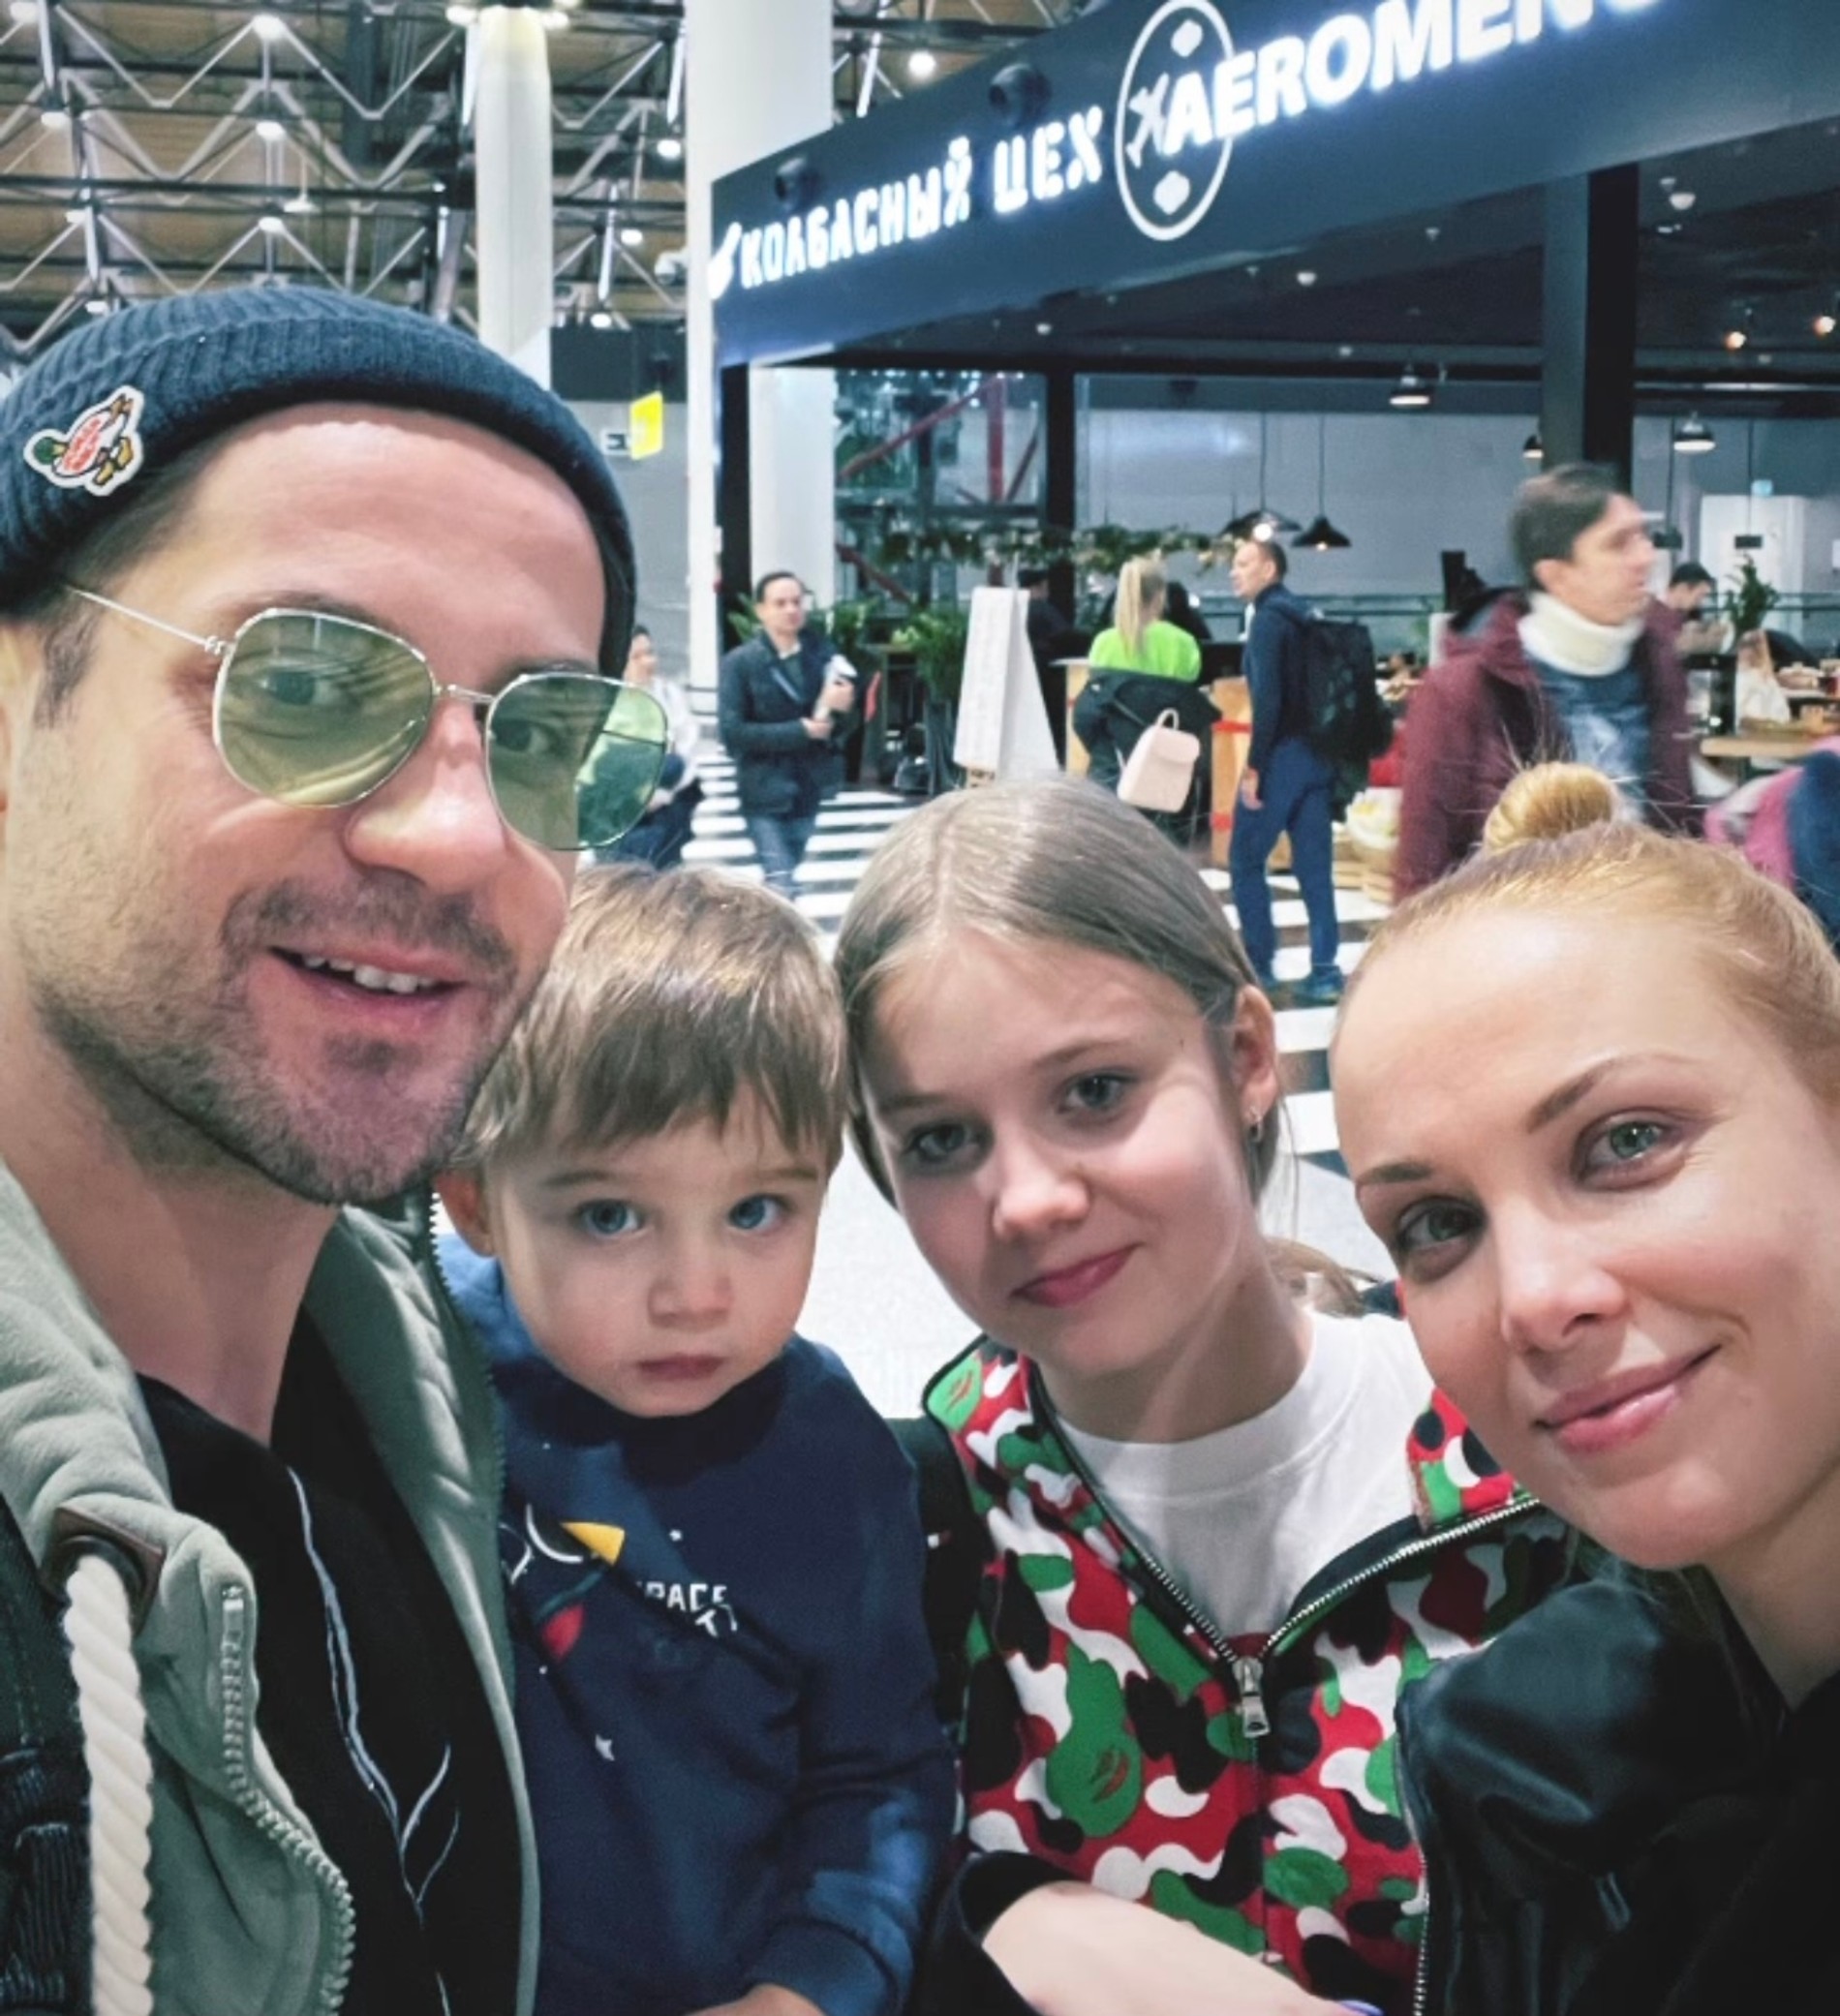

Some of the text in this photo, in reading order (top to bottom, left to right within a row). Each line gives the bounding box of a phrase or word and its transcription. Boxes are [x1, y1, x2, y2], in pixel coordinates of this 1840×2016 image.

[1163, 0, 1658, 156] AEROME
[740, 106, 1104, 289] КОЛБАСНЫЙ ЦЕХ
[636, 1580, 728, 1613] PACE
